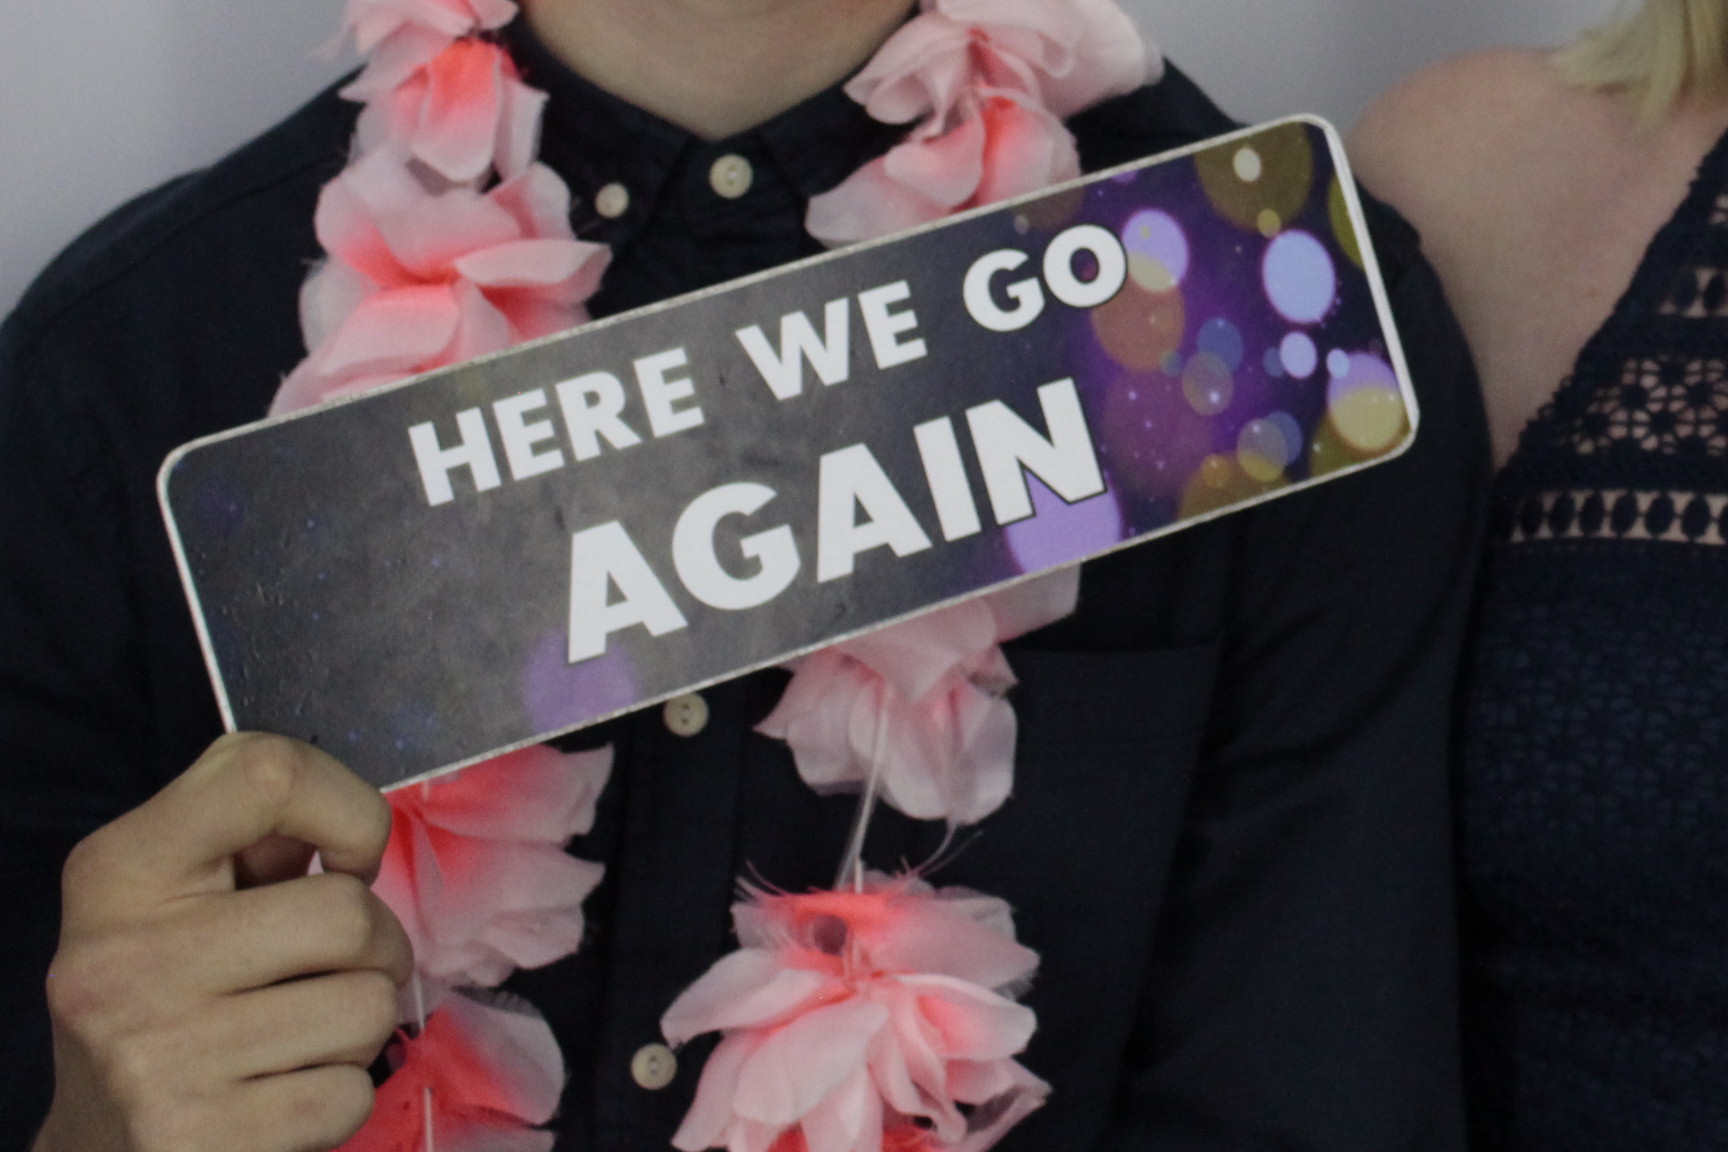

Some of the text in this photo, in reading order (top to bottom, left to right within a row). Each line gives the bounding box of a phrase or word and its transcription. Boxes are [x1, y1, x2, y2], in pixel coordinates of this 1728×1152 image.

[408, 223, 1129, 506] HERE WE GO
[567, 378, 1107, 665] AGAIN
